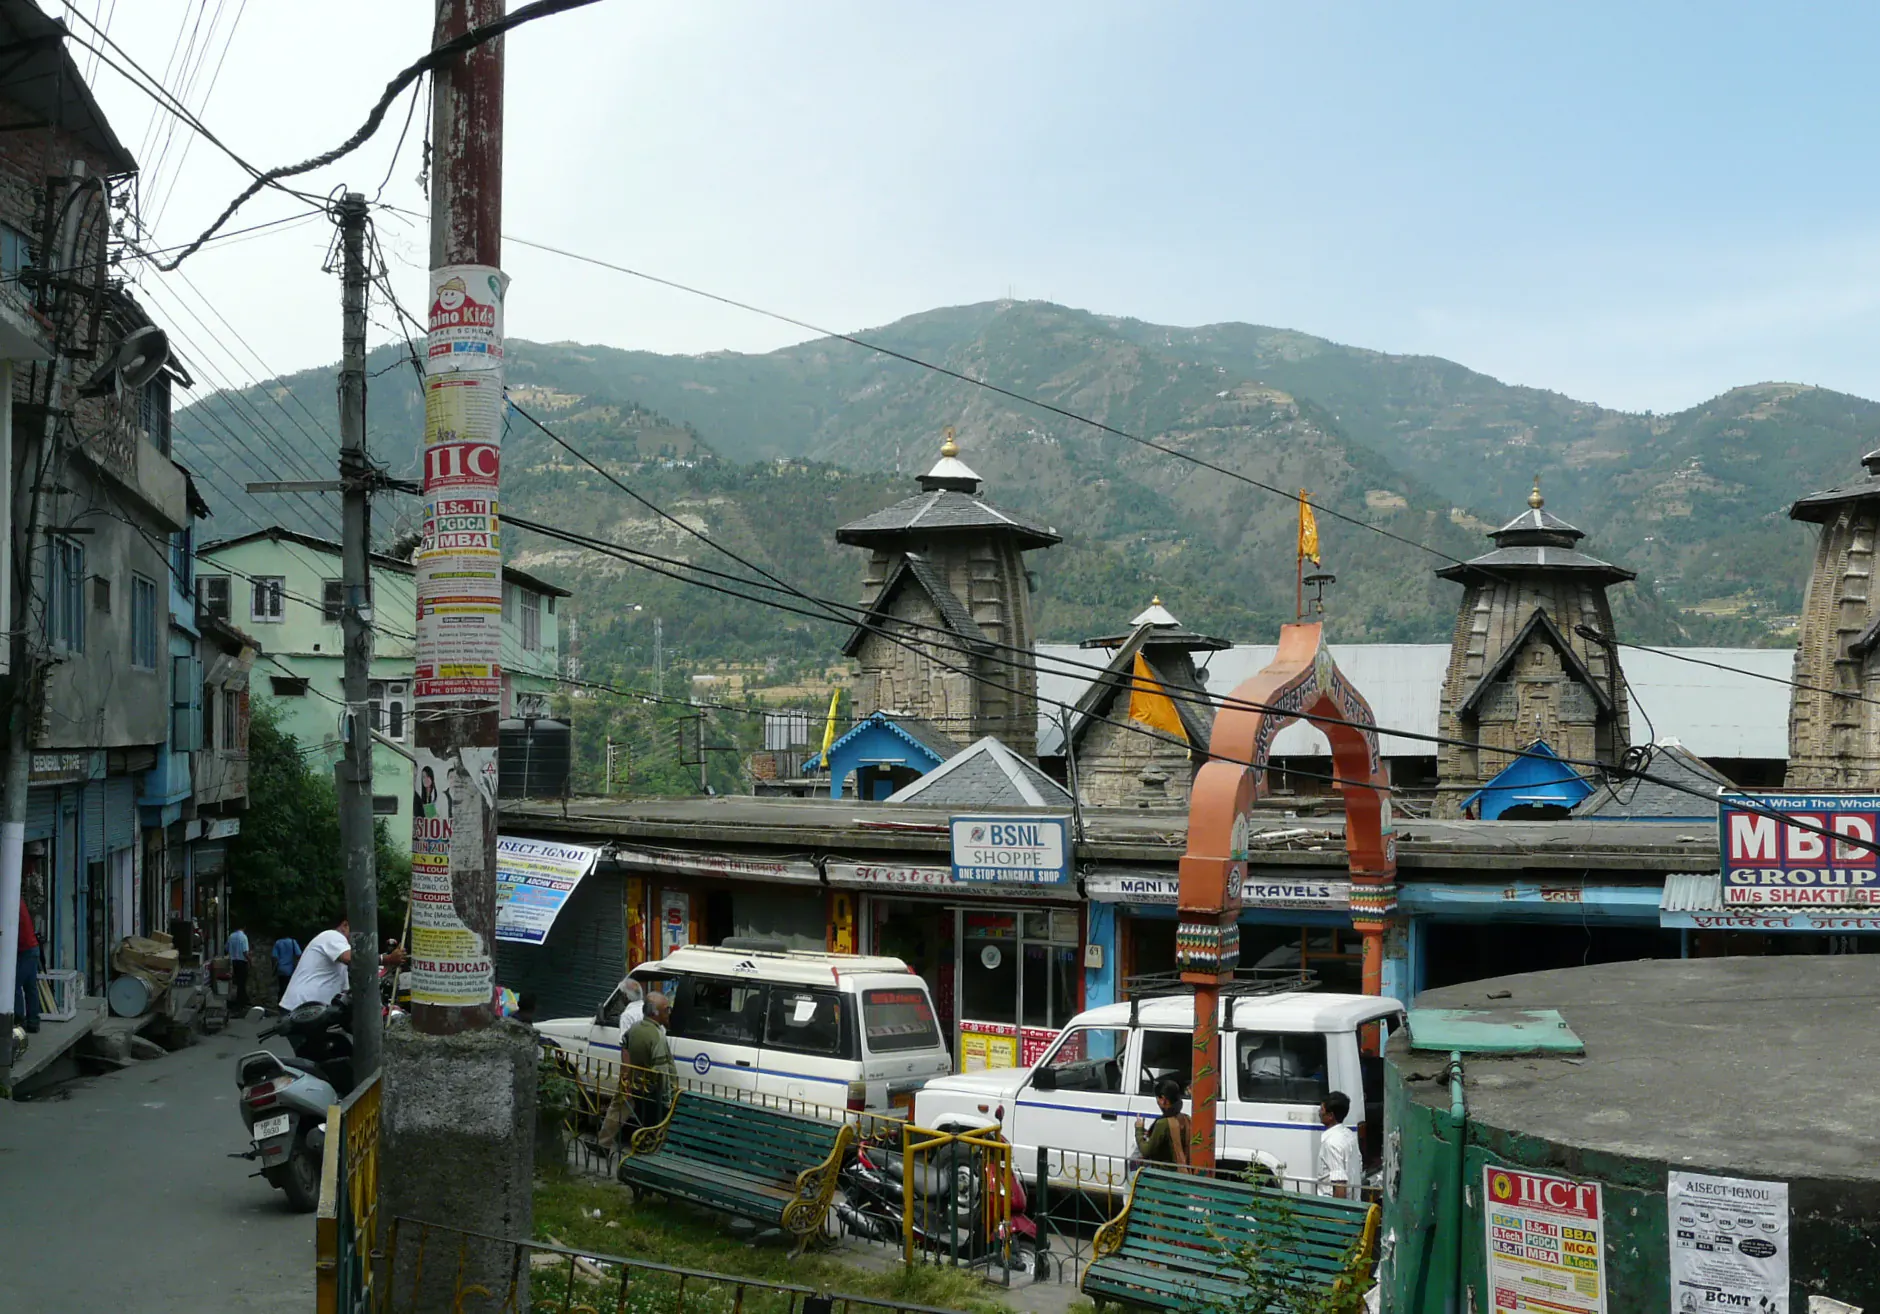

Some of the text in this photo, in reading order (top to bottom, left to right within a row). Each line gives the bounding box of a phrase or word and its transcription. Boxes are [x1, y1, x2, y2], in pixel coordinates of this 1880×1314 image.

[463, 306, 493, 325] Kids
[428, 446, 499, 480] IIC
[438, 501, 484, 514] B.Sc. IT
[439, 517, 484, 531] PGDCA
[440, 535, 485, 547] MBA
[1770, 799, 1806, 808] What
[1811, 799, 1836, 808] The
[991, 825, 1045, 846] BSNL
[1731, 815, 1873, 860] MBD
[974, 851, 1042, 865] SHOPPE
[959, 868, 974, 880] ONE
[975, 868, 995, 880] STOP
[1038, 870, 1060, 883] SHOP
[1730, 869, 1877, 885] GROUP
[1121, 881, 1162, 893] MANI
[1244, 885, 1330, 898] TRAVELS
[1730, 888, 1762, 902] M/s
[1769, 889, 1846, 903] SHAKTI
[1518, 1176, 1591, 1211] IICT
[1686, 1181, 1769, 1200] AISECT-IGNOU
[1494, 1215, 1595, 1242] BCA B.Sc. IT BBA
[1493, 1228, 1595, 1255] B.Tech. PGDCA MCA
[1494, 1241, 1597, 1270] M.Sc.IT MBA M.Tech.
[1705, 1291, 1751, 1307] BCMT
